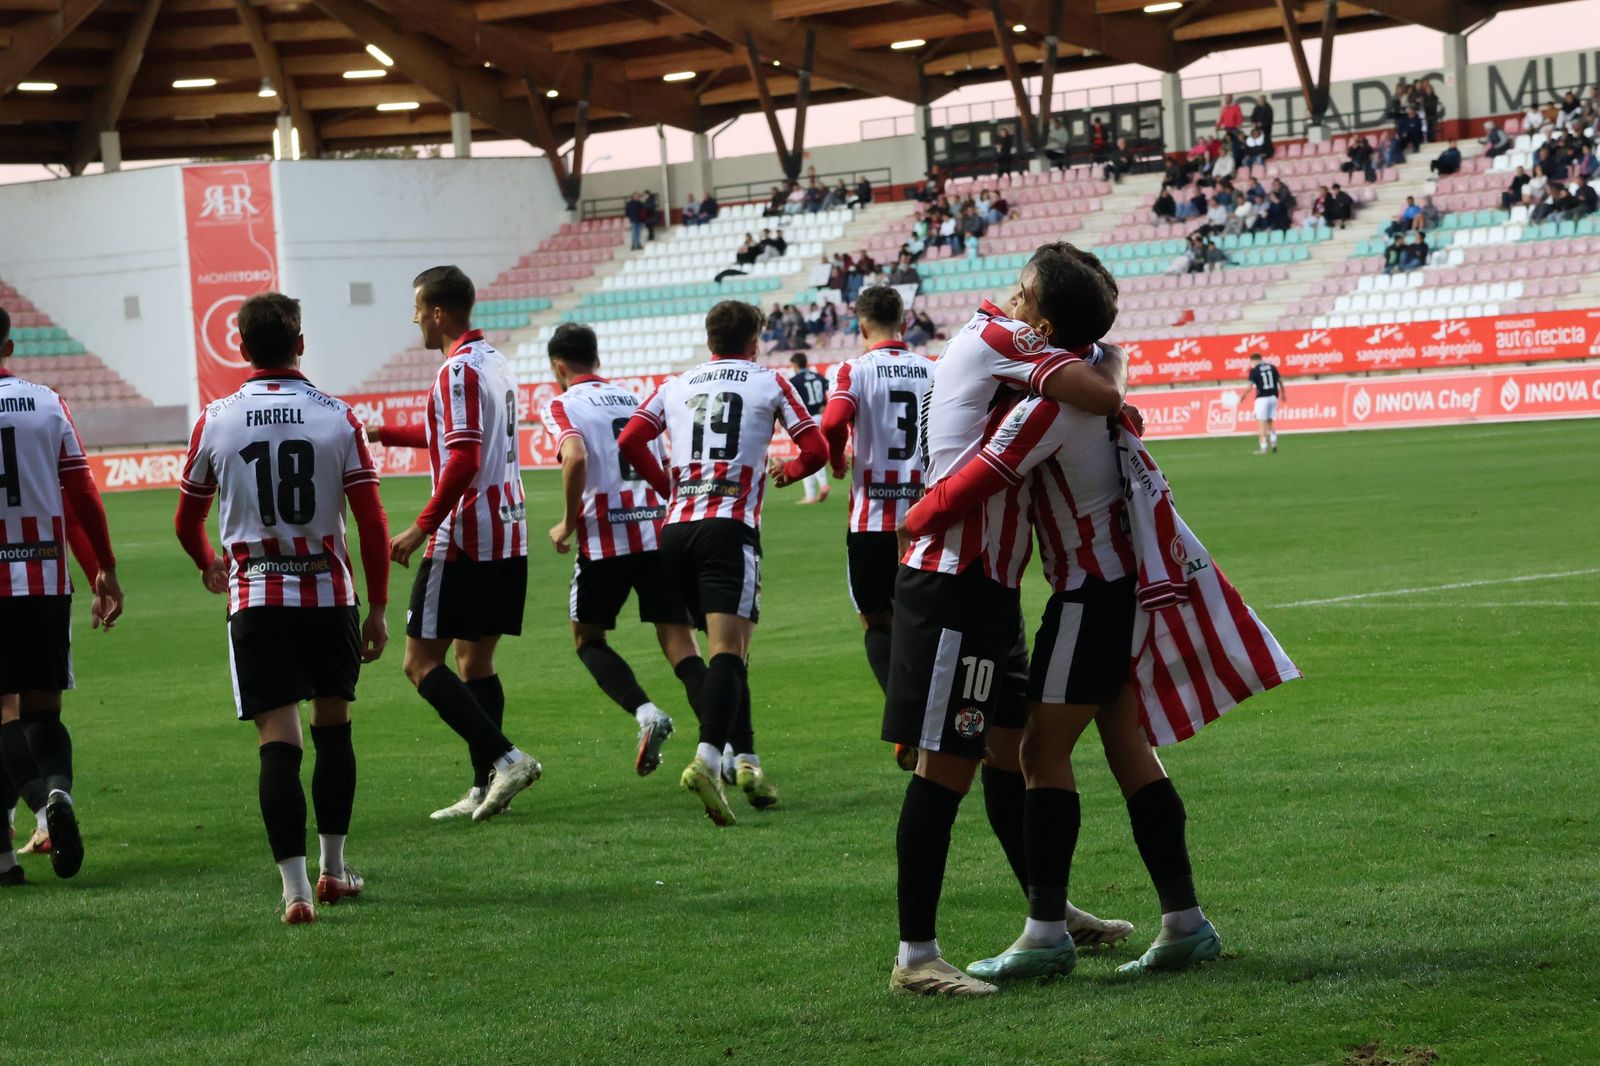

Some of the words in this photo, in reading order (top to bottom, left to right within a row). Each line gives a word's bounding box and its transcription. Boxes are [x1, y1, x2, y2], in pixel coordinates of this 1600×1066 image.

[1488, 51, 1600, 113] MU
[688, 369, 749, 385] MONERRIS
[1261, 370, 1274, 390] 11
[1524, 380, 1589, 404] INNOVA
[1375, 390, 1434, 413] INNOVA
[1437, 387, 1482, 412] Chef
[246, 408, 305, 427] FARRELL
[685, 391, 744, 461] 19
[888, 390, 918, 460] 3
[239, 439, 316, 527] 18
[1130, 455, 1158, 498] RULOSA
[247, 559, 329, 574] leomotor.net
[961, 655, 995, 702] 10
